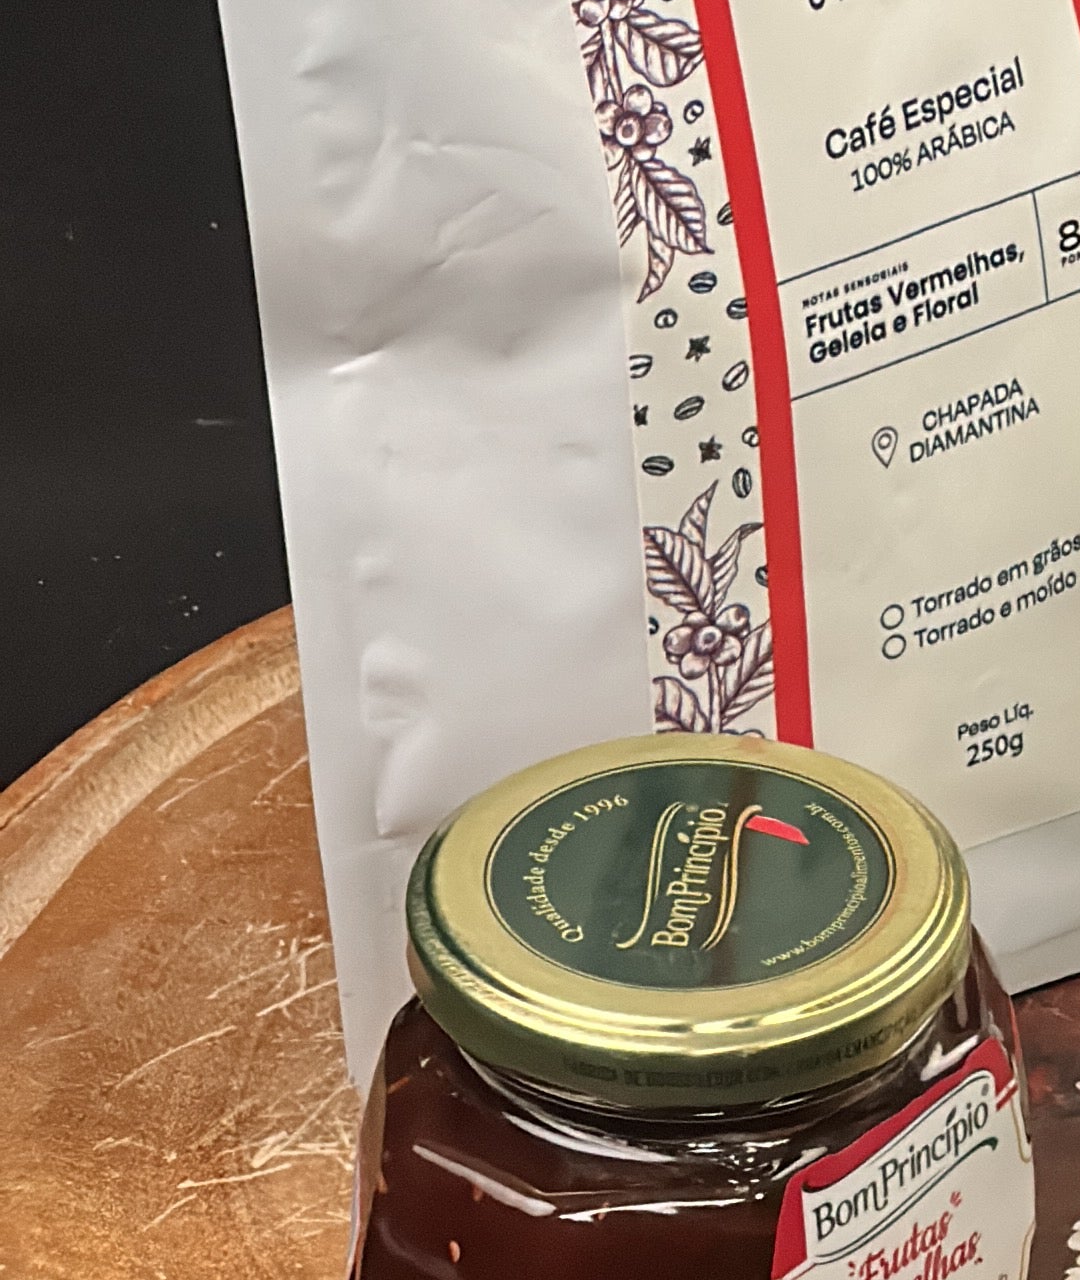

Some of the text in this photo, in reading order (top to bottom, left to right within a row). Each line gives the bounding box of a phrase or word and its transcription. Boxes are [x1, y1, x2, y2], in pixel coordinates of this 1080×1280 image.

[824, 56, 1025, 160] Café Especial
[851, 110, 1016, 192] 100% ARÁBICA
[801, 261, 909, 310] NOTAS SENSORIAIS
[805, 242, 1025, 338] Frutas Vermelhas,
[809, 281, 979, 364] Geleia e Floral
[909, 397, 1040, 463] DIAMANTINA
[922, 377, 1024, 432] CHAPADA
[911, 575, 993, 618] Torrado
[997, 561, 1028, 586] em
[914, 571, 1077, 648] Torrado e moído
[957, 702, 1034, 740] Peso Líq.
[966, 732, 1024, 767] 250g
[523, 794, 629, 942] Qualidade desde 1996
